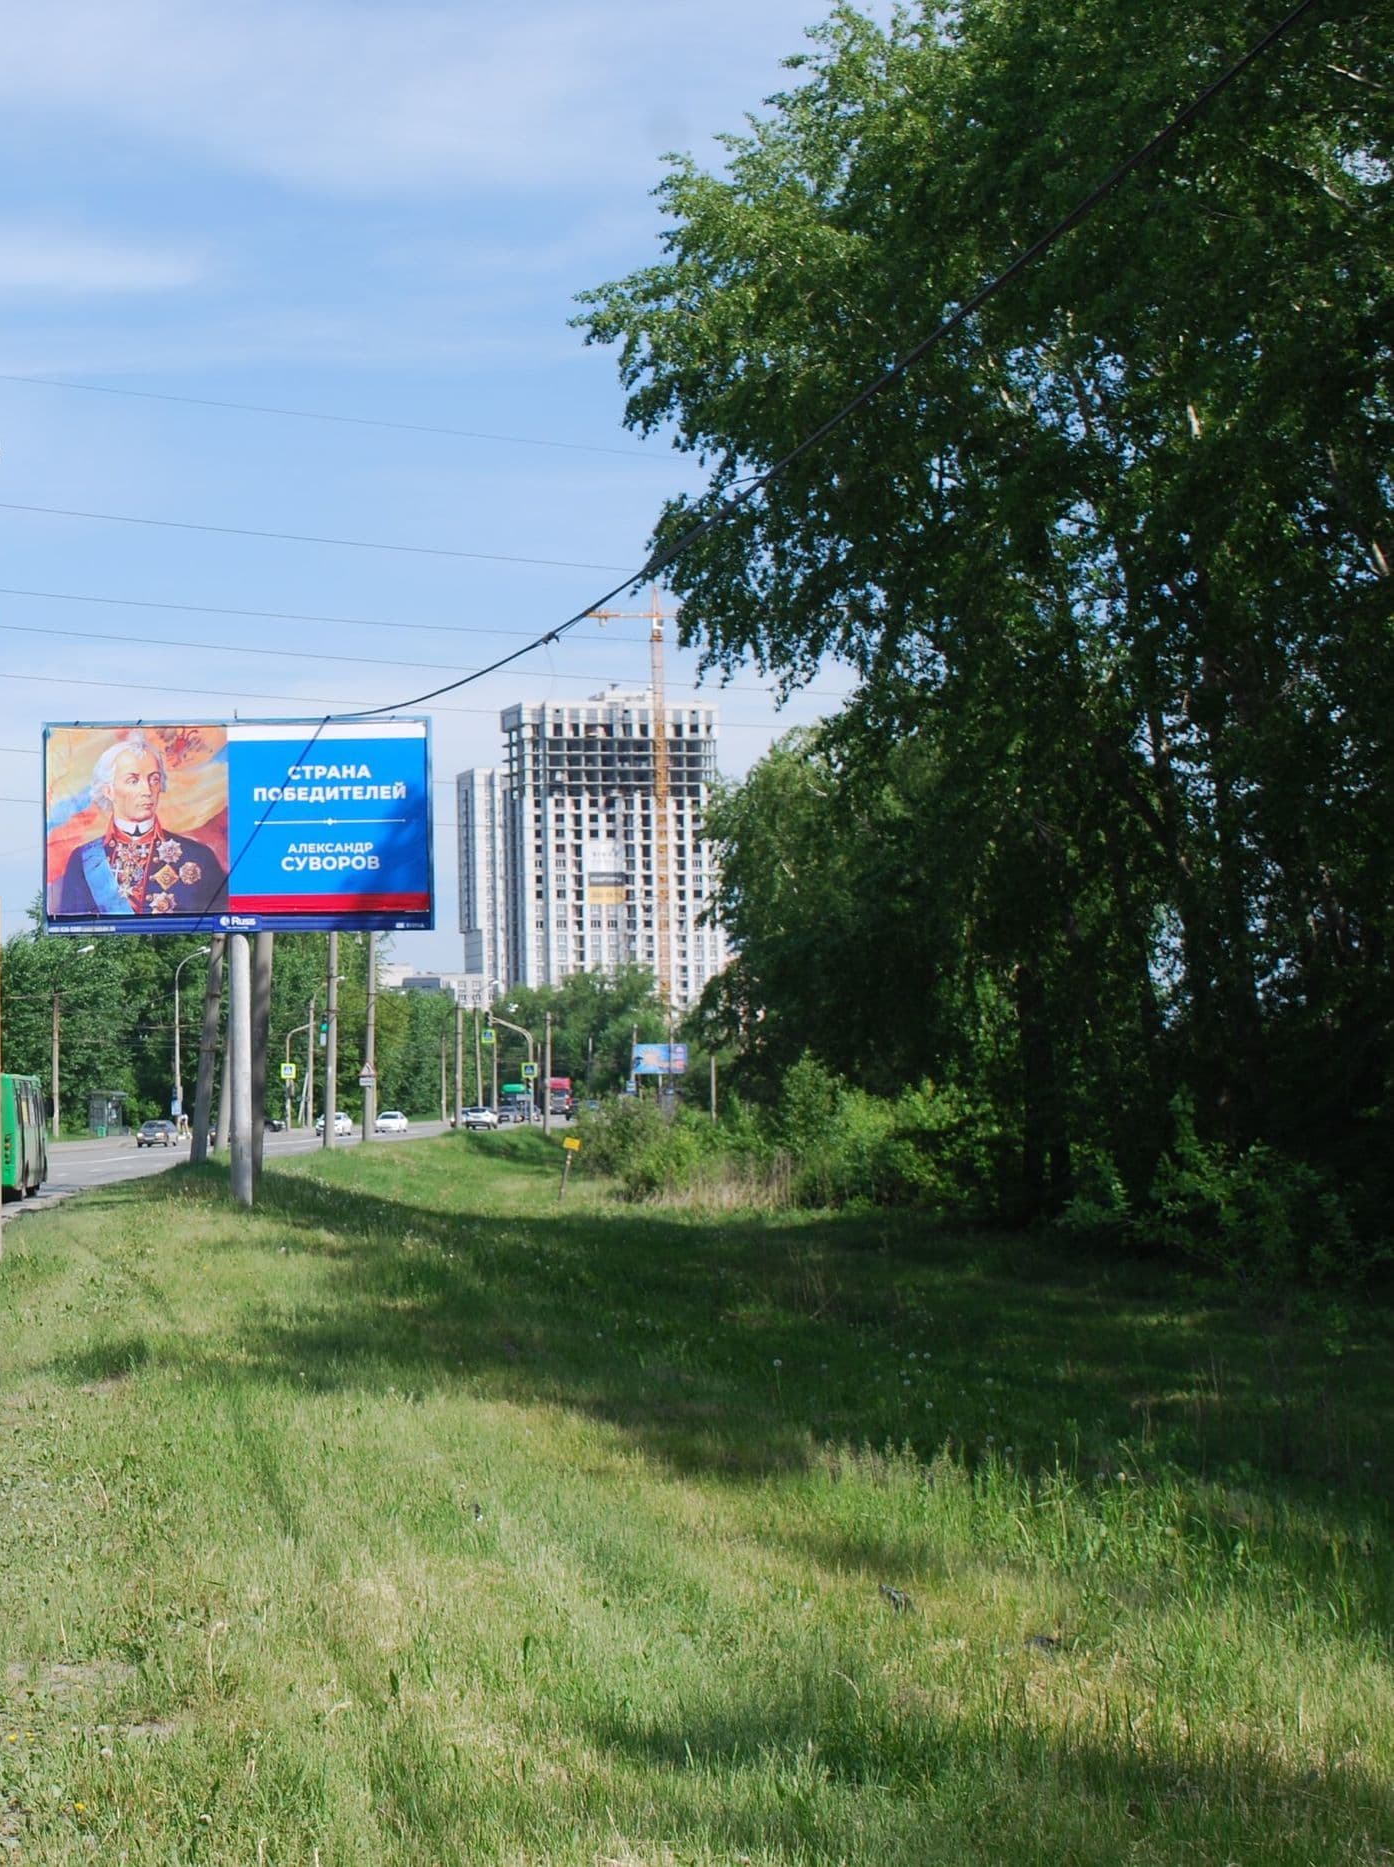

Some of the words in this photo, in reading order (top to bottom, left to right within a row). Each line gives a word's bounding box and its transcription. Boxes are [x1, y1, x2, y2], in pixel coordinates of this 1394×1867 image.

[287, 764, 372, 780] СТРАНА
[253, 782, 407, 803] ПОБЕДИТЕЛЕЙ
[287, 842, 374, 854] АЛЕКСАНДР
[281, 855, 381, 871] СУВОРОВ
[231, 917, 256, 926] Russ
